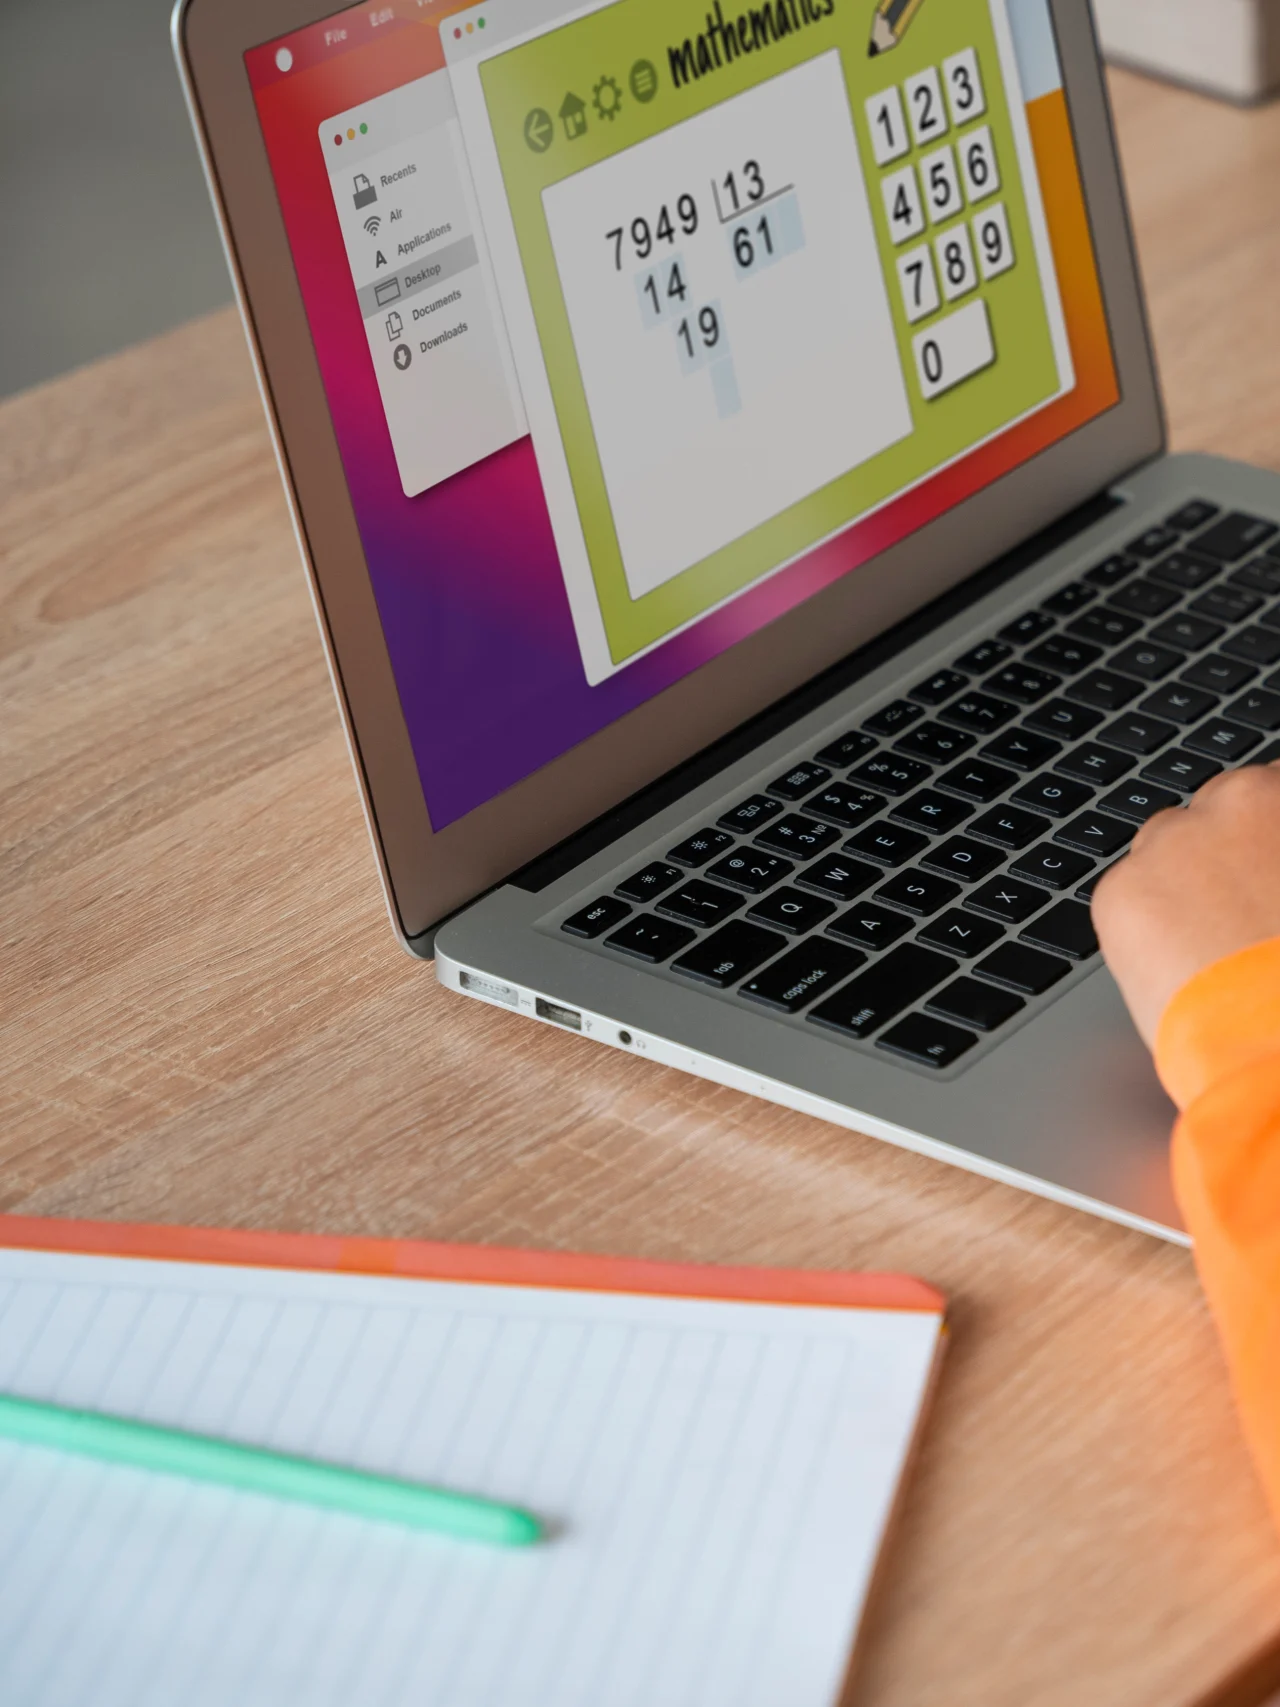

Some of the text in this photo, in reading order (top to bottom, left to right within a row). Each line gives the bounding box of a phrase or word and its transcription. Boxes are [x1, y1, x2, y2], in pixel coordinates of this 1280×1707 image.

[369, 8, 395, 28] Edit
[323, 28, 348, 47] File
[952, 65, 974, 110] 3
[914, 85, 937, 131] 2
[877, 105, 895, 147] 1
[967, 143, 988, 187] 6
[379, 163, 417, 188] Recents
[723, 159, 766, 210] 13
[930, 162, 951, 208] 5
[893, 184, 912, 225] 4
[389, 207, 403, 224] Air
[605, 193, 699, 271] 7949
[397, 223, 452, 256] Applications
[733, 216, 773, 269] 61
[982, 221, 1002, 264] 9
[945, 241, 966, 285] 8
[404, 264, 442, 289] Desktop
[905, 260, 923, 306] 7
[644, 262, 687, 314] 14
[411, 290, 462, 321] Documents
[419, 322, 469, 354] Downloads
[678, 306, 720, 357] 19
[922, 339, 943, 384] 0
[1169, 695, 1189, 707] K
[1052, 711, 1073, 723] U
[1130, 726, 1146, 736] J
[937, 740, 953, 749] 6
[1212, 731, 1235, 745] M
[1009, 741, 1028, 752] Y
[1083, 755, 1106, 768] H
[1170, 762, 1193, 774] N
[891, 770, 909, 780] 5
[965, 772, 984, 782] T
[1042, 787, 1062, 798] G
[847, 802, 863, 811] 4
[1128, 795, 1149, 805] B
[920, 805, 942, 815] R
[998, 819, 1014, 830] F
[1084, 825, 1104, 836] V
[798, 834, 816, 843] 3
[875, 836, 896, 847] E
[951, 852, 972, 863] D
[1042, 858, 1062, 868] C
[750, 867, 770, 876] 2
[824, 867, 850, 881] W
[906, 885, 925, 896] S
[995, 891, 1018, 904] X
[586, 907, 606, 920] esc
[780, 902, 803, 913] Q
[860, 919, 881, 931] A
[948, 925, 971, 937] Z
[713, 962, 735, 975] tab
[782, 968, 828, 1001] caps lock
[850, 1007, 876, 1027] shift
